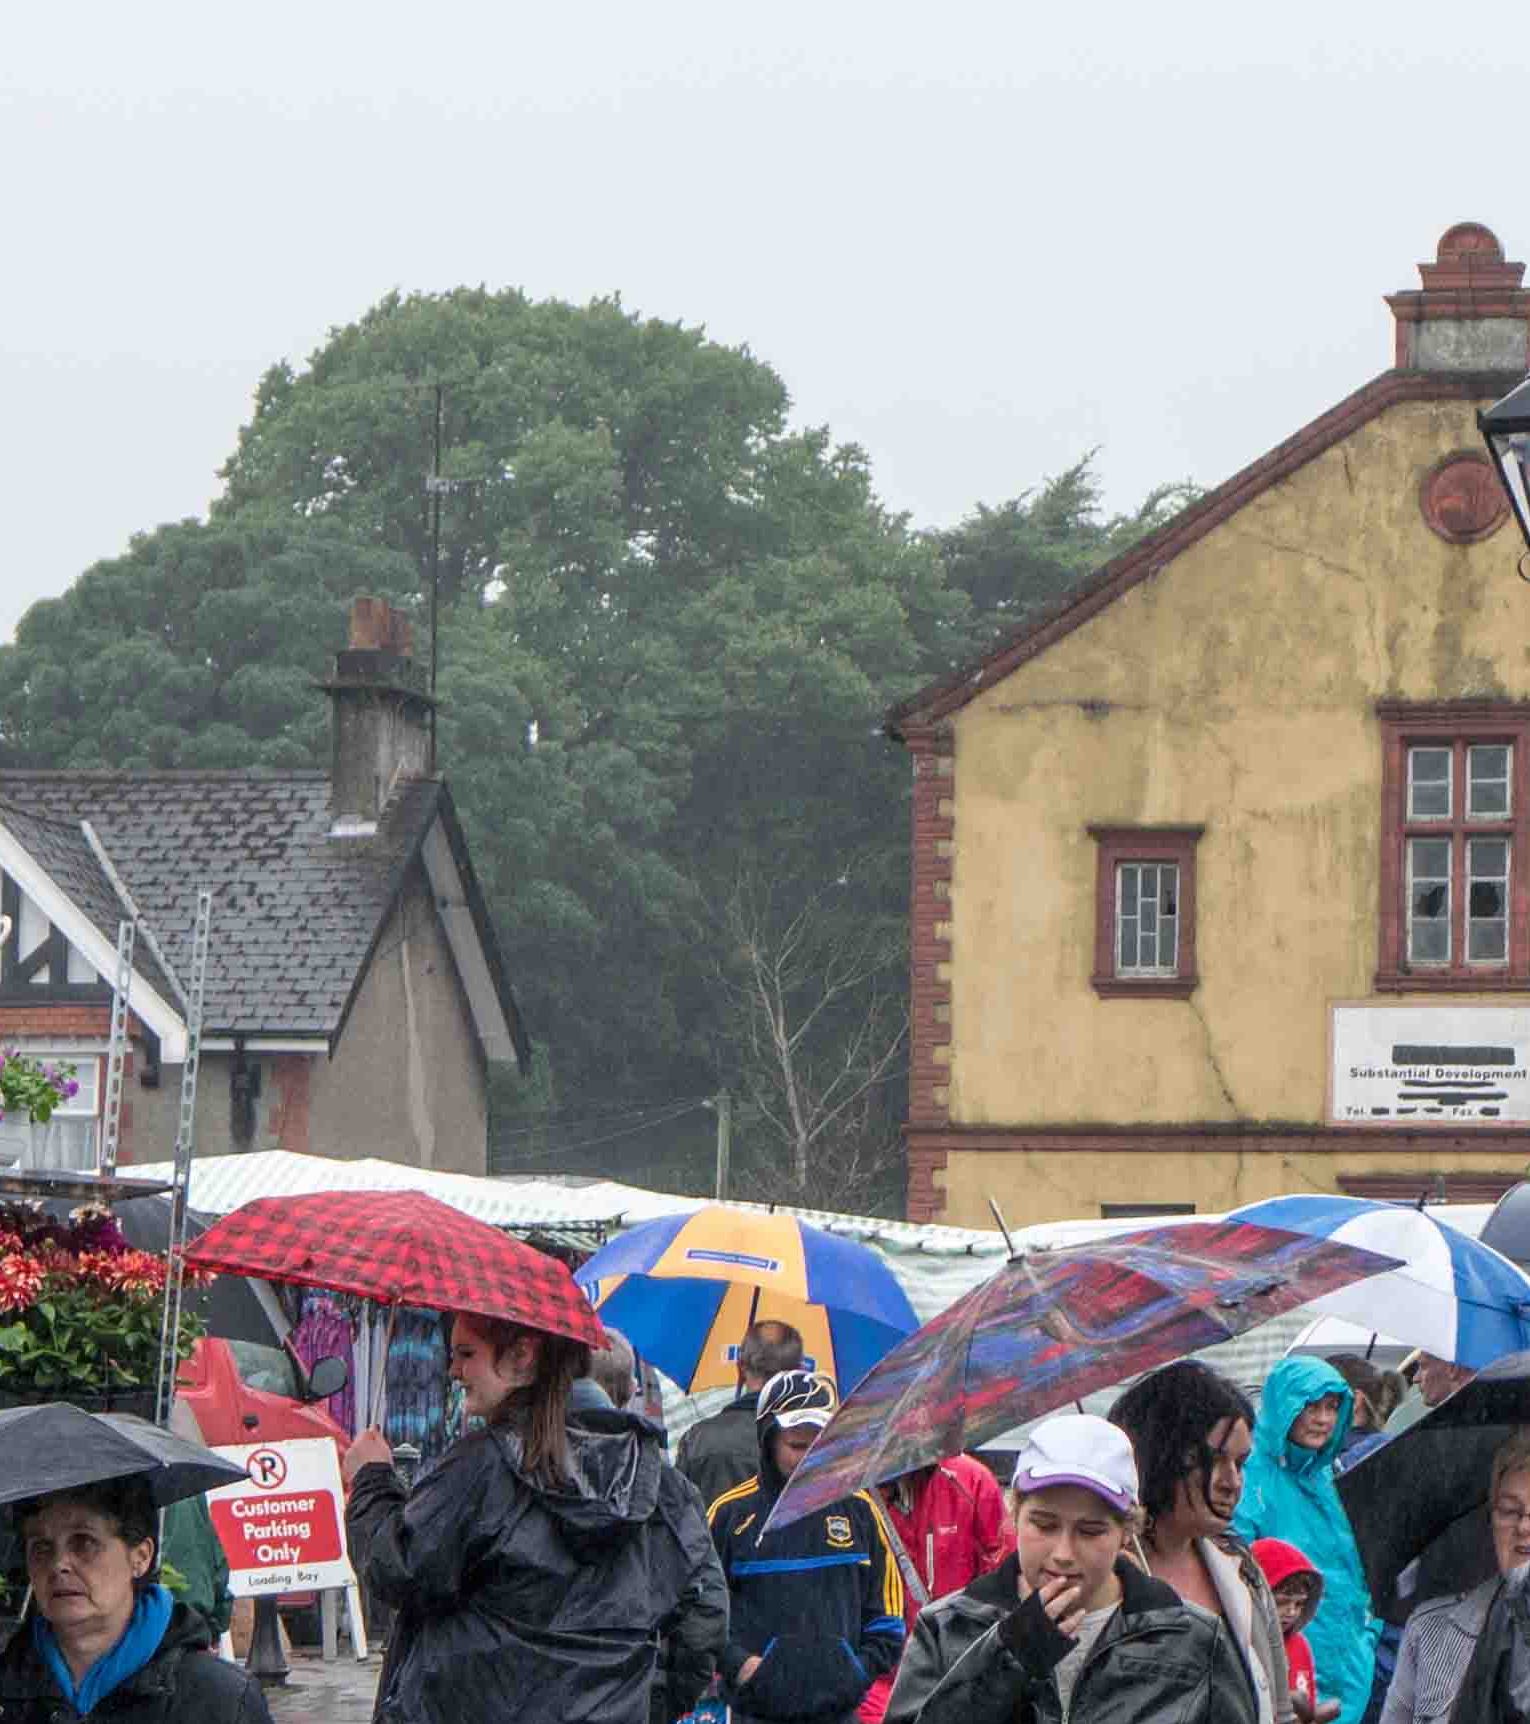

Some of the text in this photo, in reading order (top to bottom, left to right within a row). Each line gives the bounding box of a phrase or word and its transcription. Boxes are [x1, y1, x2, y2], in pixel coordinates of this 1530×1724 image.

[1349, 1067, 1430, 1079] Substantial
[1435, 1067, 1527, 1081] Development
[231, 1497, 317, 1518] Customer
[243, 1519, 311, 1541] Parking
[256, 1541, 301, 1562] Only
[248, 1570, 319, 1586] Loading Bay
